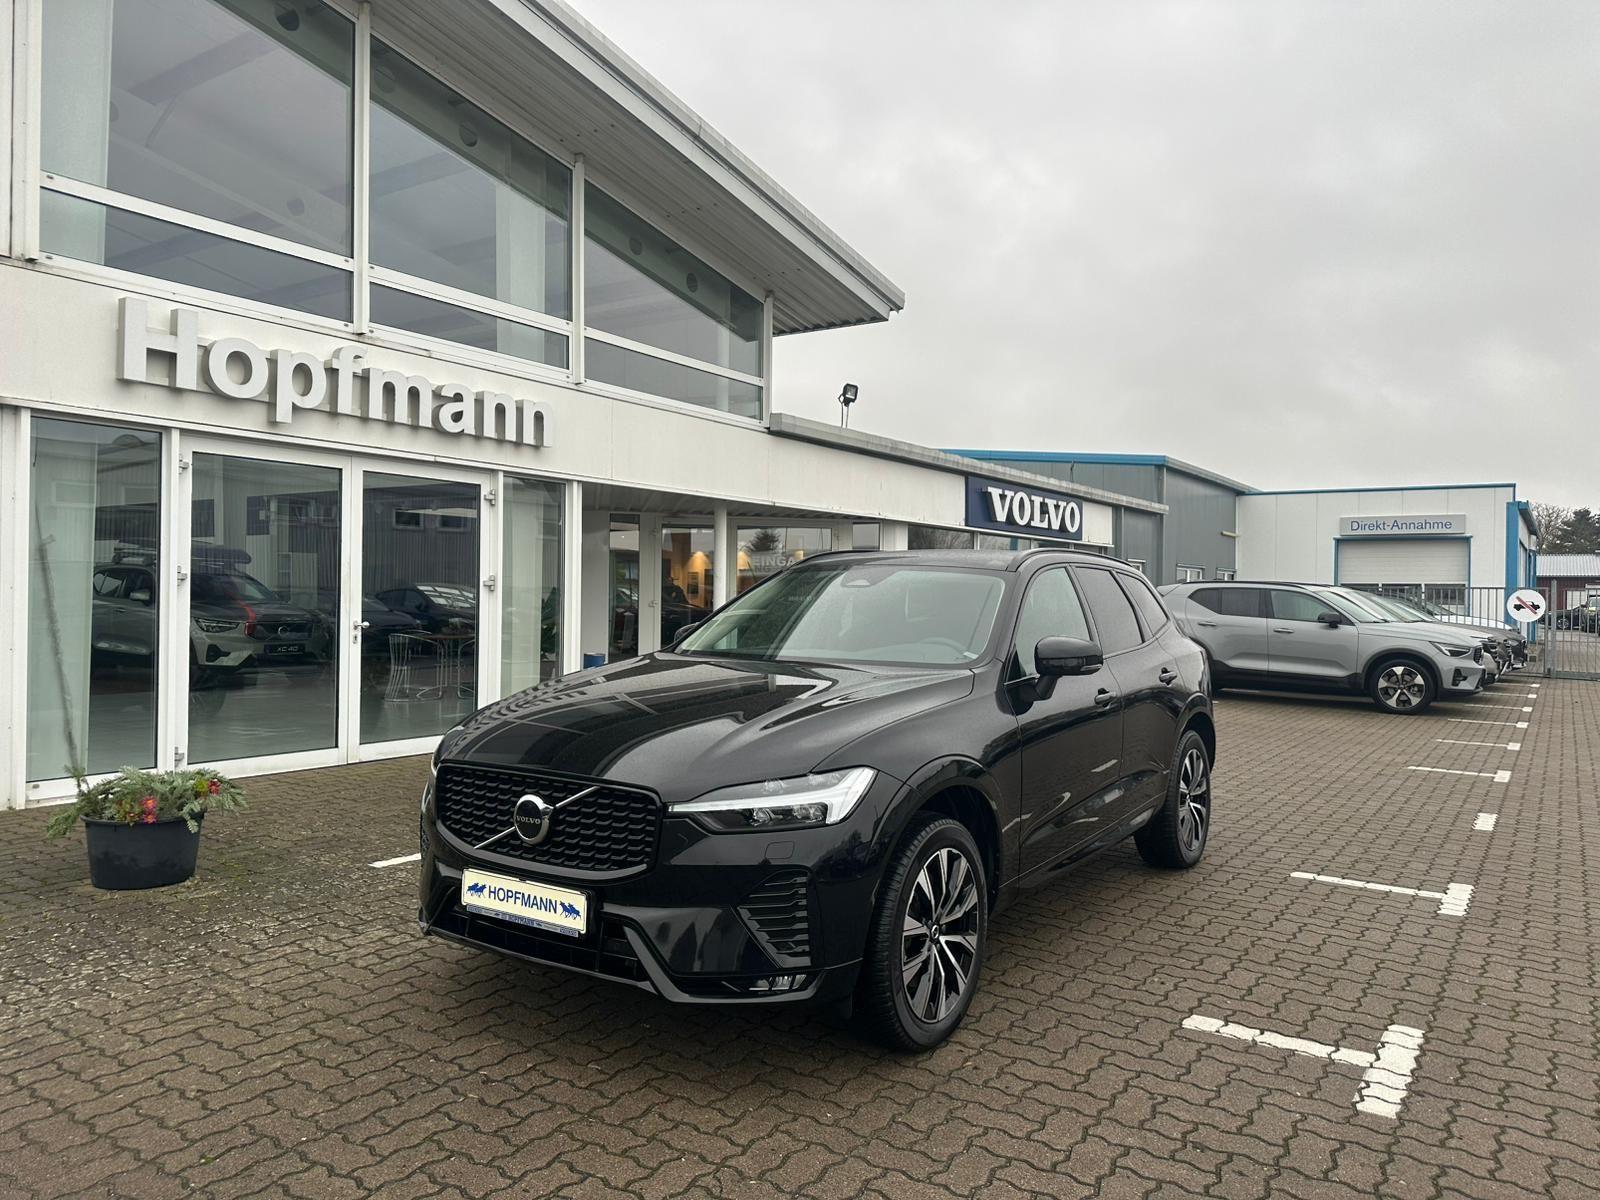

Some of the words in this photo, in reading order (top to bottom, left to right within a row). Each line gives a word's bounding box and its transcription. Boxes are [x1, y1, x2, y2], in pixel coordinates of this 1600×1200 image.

[118, 297, 554, 447] Hopfmann
[987, 486, 1080, 533] VOLVO
[1350, 519, 1453, 531] Direkt-Annahme
[516, 815, 541, 825] VOLVO
[488, 885, 558, 914] HOPFMANN
